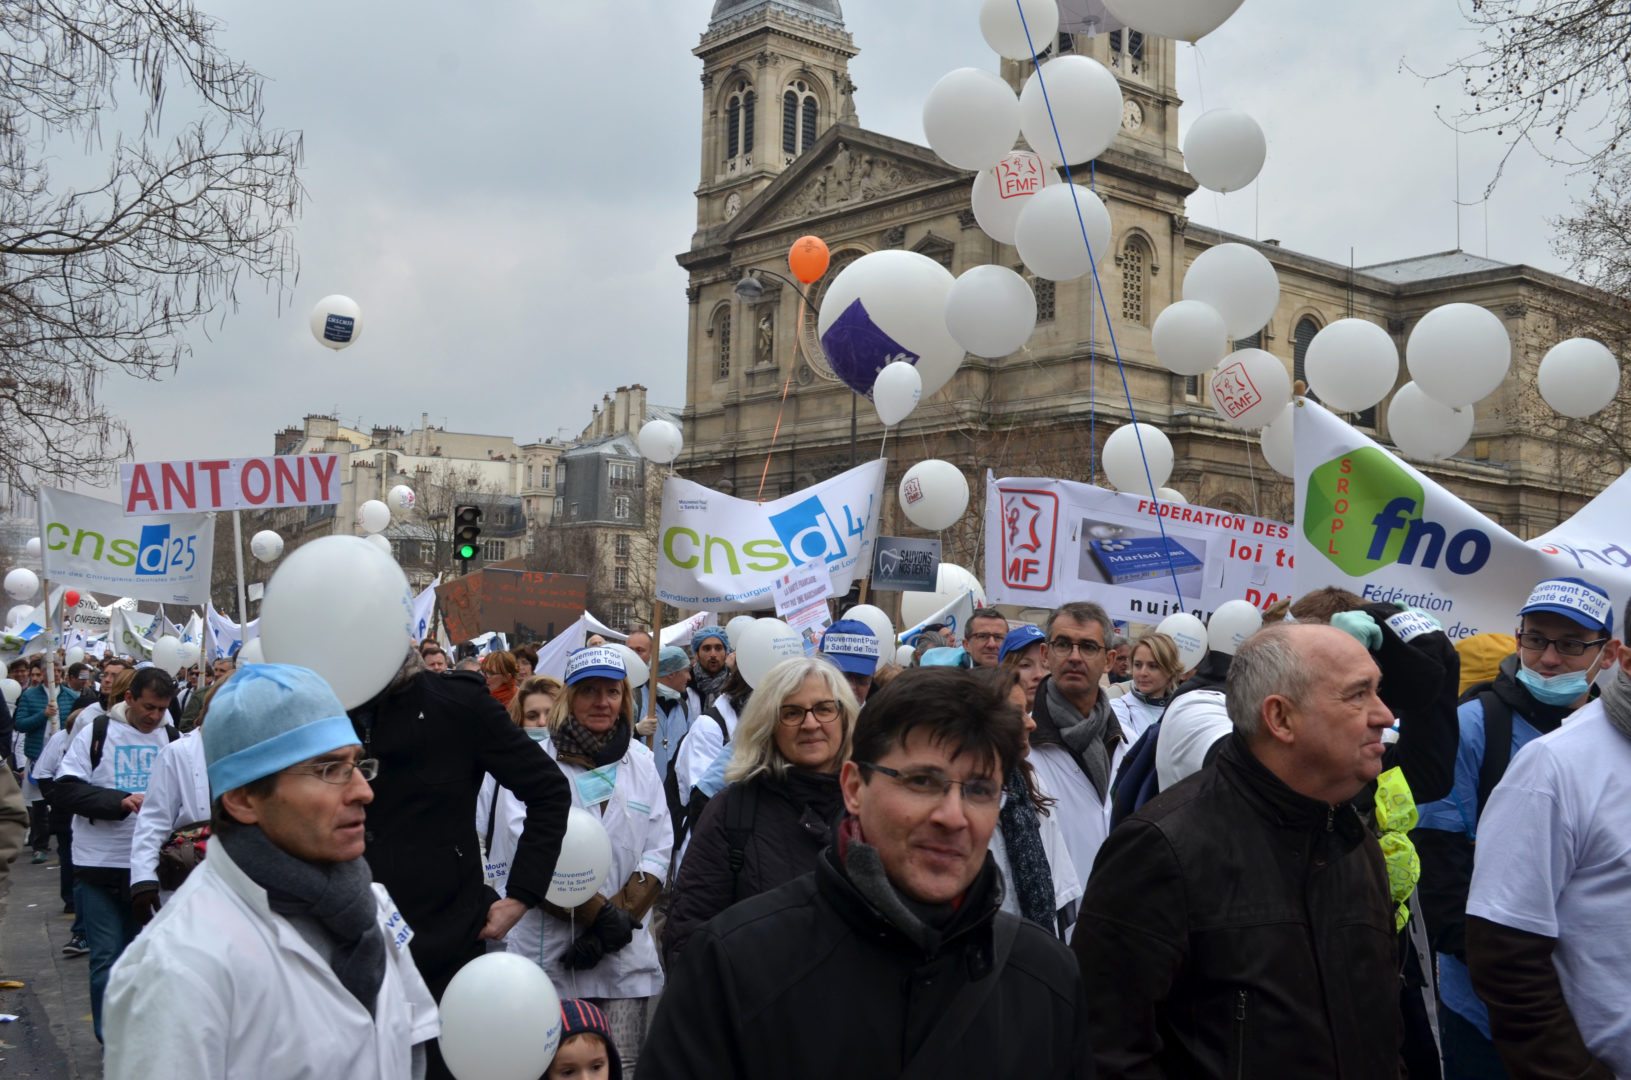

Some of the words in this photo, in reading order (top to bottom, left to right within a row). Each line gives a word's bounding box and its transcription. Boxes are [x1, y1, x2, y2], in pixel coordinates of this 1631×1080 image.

[1006, 177, 1039, 194] FMF
[1227, 391, 1253, 414] FMF
[126, 455, 338, 513] ANTONY
[1137, 499, 1246, 531] FEDERATION
[1252, 521, 1289, 540] DES
[1366, 496, 1492, 576] fno
[1108, 551, 1161, 563] Marisol
[1229, 538, 1263, 563] loi
[911, 564, 932, 575] DENTS
[660, 590, 699, 603] Syndicat
[702, 595, 721, 603] des
[1130, 598, 1180, 617] nuit
[1362, 583, 1453, 613] Fédération
[1559, 595, 1574, 604] de
[1578, 598, 1601, 618] Tous
[1581, 589, 1606, 608] Pour
